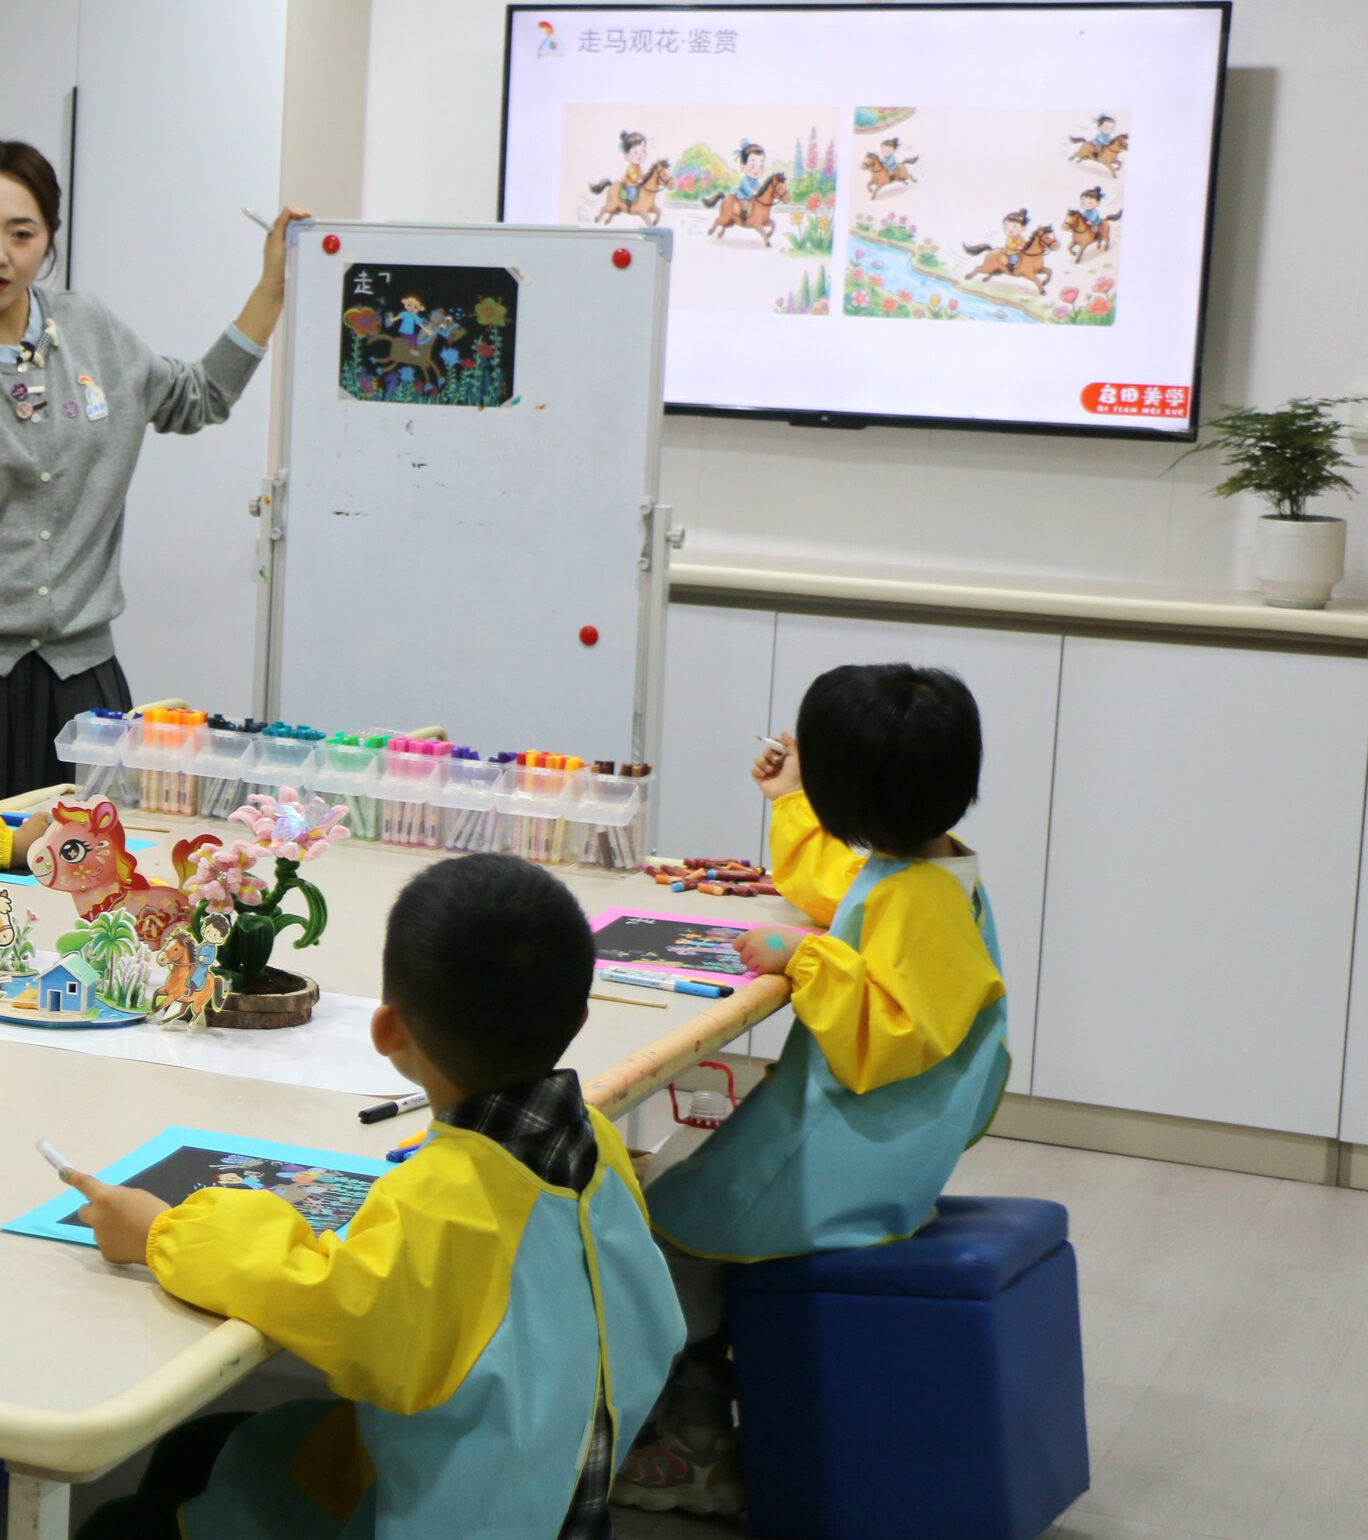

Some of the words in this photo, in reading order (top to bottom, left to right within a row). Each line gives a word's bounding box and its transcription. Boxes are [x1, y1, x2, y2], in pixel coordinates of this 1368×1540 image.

[578, 28, 739, 54] 走马观花·鉴赏
[1098, 384, 1184, 407] 启田美学
[1141, 407, 1161, 415] MEI
[1164, 408, 1185, 416] XUE
